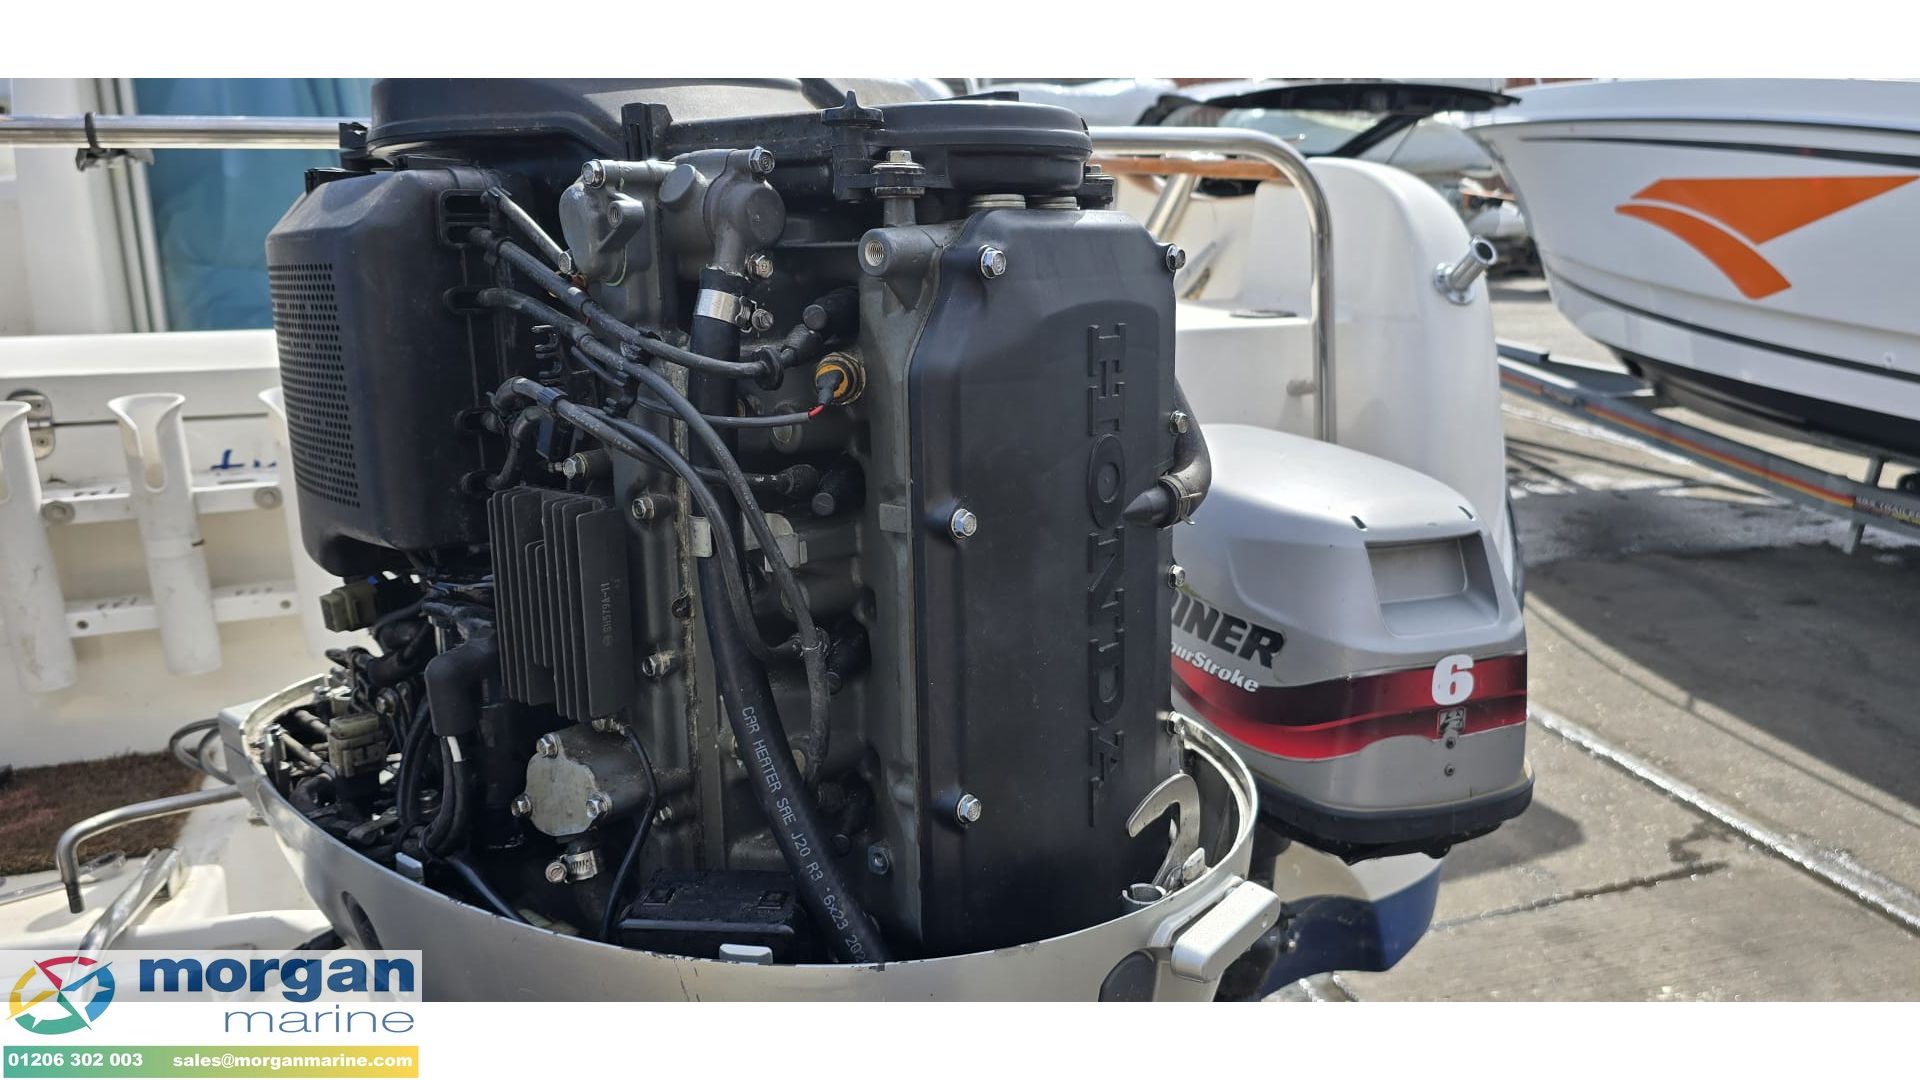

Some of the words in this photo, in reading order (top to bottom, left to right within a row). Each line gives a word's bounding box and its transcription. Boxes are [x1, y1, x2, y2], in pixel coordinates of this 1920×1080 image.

[1088, 323, 1126, 827] HONDA
[1171, 590, 1285, 668] INER
[1431, 654, 1475, 706] 6
[742, 706, 760, 734] CAR
[753, 739, 782, 793] HEATER
[776, 797, 797, 826] SAE
[791, 832, 811, 858] J20
[806, 862, 824, 882] R3
